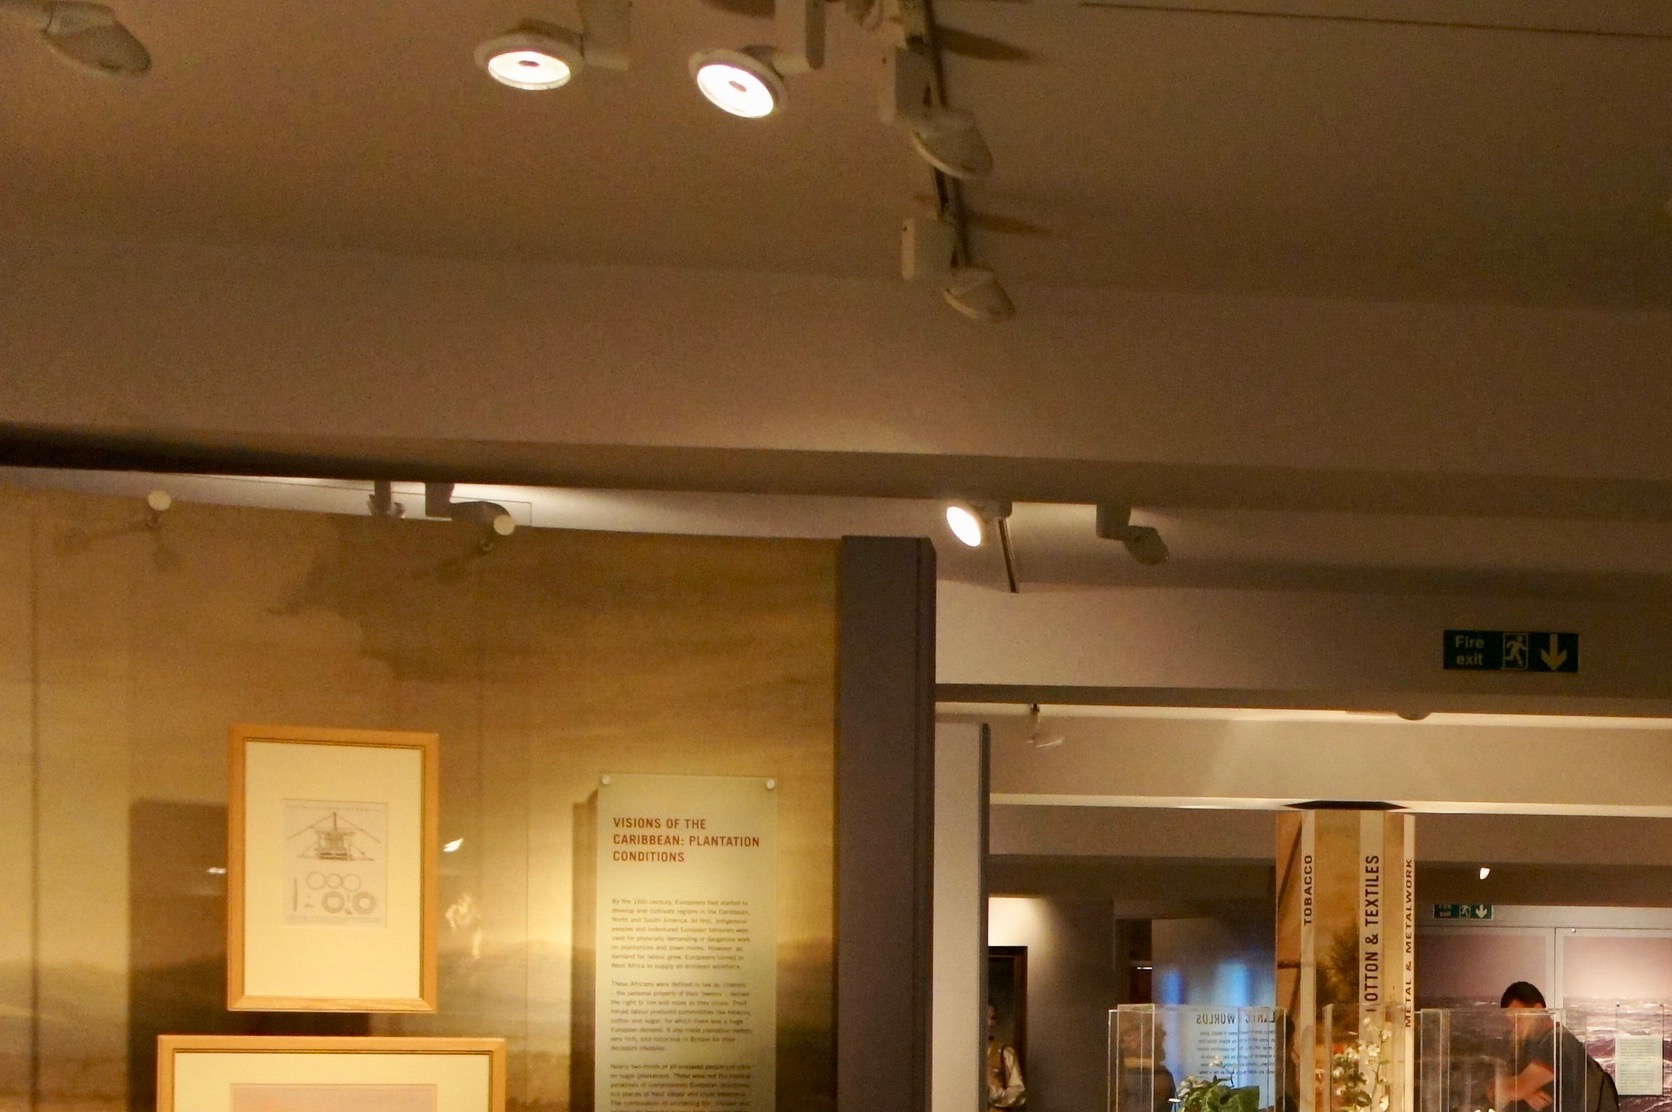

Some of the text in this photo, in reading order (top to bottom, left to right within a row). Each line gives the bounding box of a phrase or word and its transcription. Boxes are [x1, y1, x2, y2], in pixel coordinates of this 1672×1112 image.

[1455, 635, 1484, 649] Fire
[1457, 653, 1483, 666] exit
[613, 818, 706, 829] VISIONS OF THE
[613, 834, 760, 847] CARIBBEAN: PLANTATION
[613, 851, 684, 862] CONDITIONS
[1304, 855, 1312, 925] TOBACCO
[1365, 855, 1379, 927] TEXTILES
[1366, 934, 1378, 945] &
[1406, 961, 1411, 970] &
